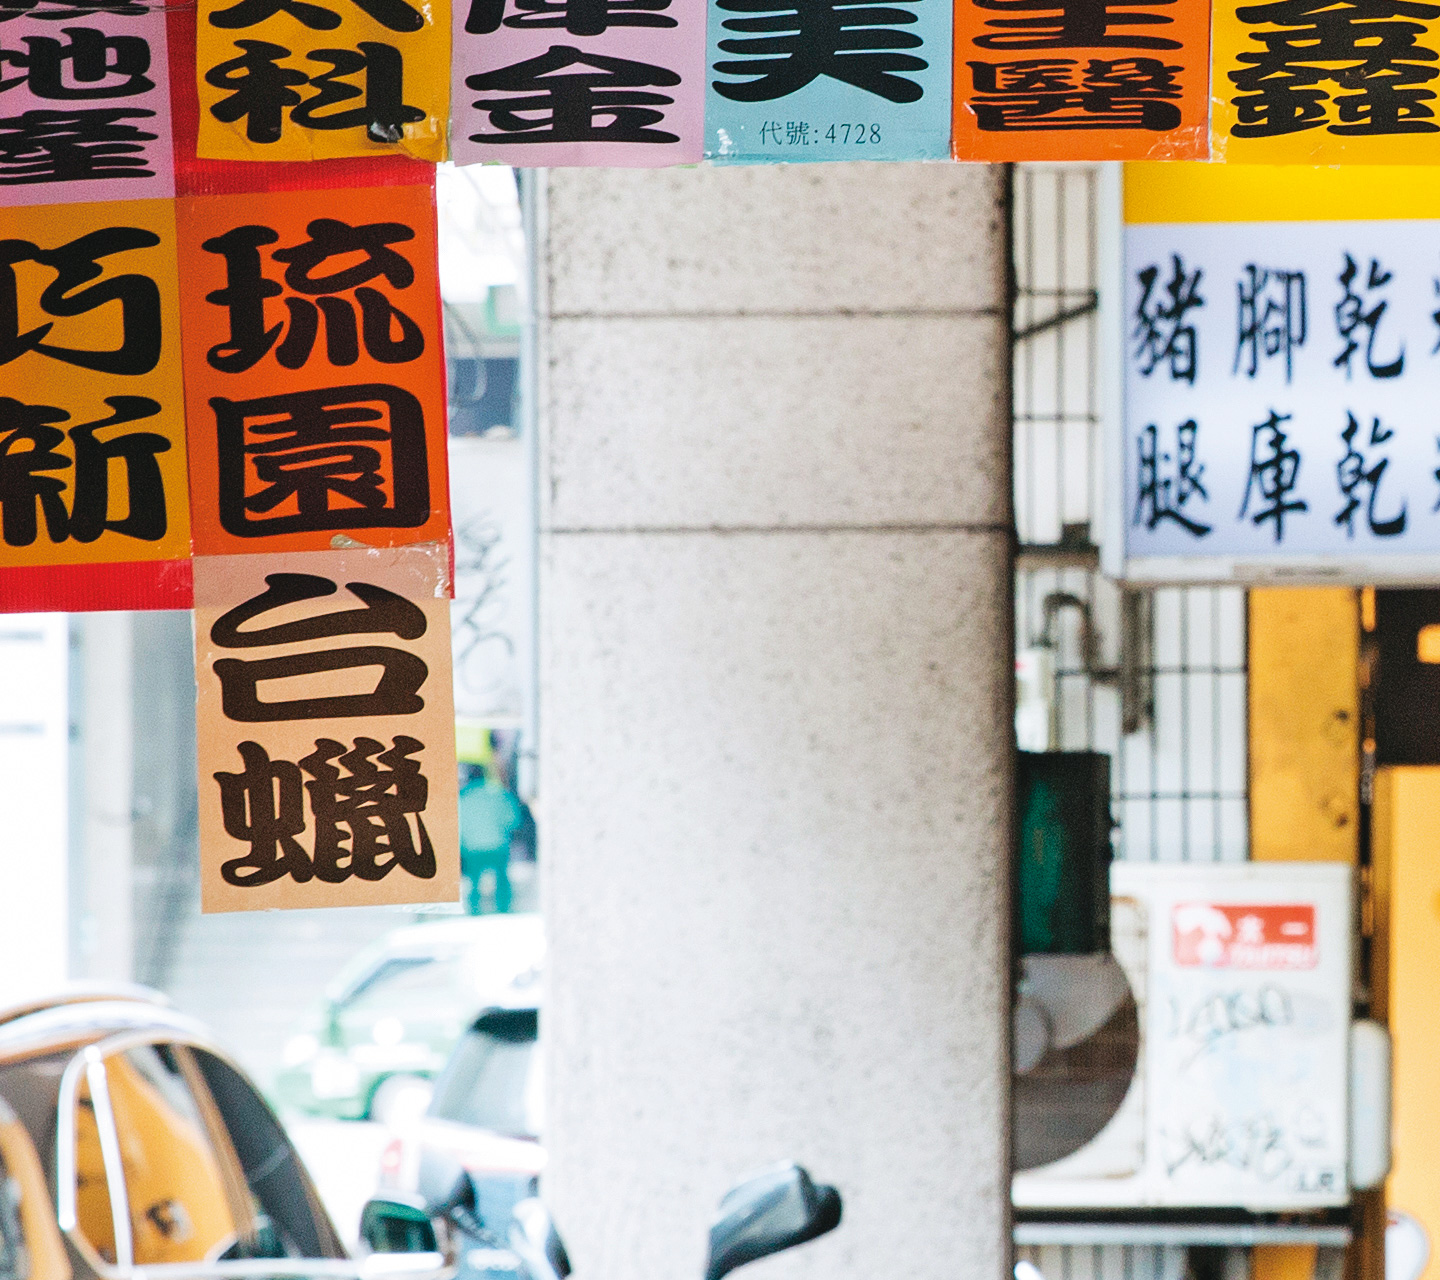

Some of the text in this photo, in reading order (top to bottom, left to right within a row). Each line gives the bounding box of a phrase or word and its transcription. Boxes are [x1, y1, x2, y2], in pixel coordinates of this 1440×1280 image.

[759, 120, 882, 147] 代號:4728
[202, 219, 430, 537] 琉園
[211, 573, 436, 886] 台蠟
